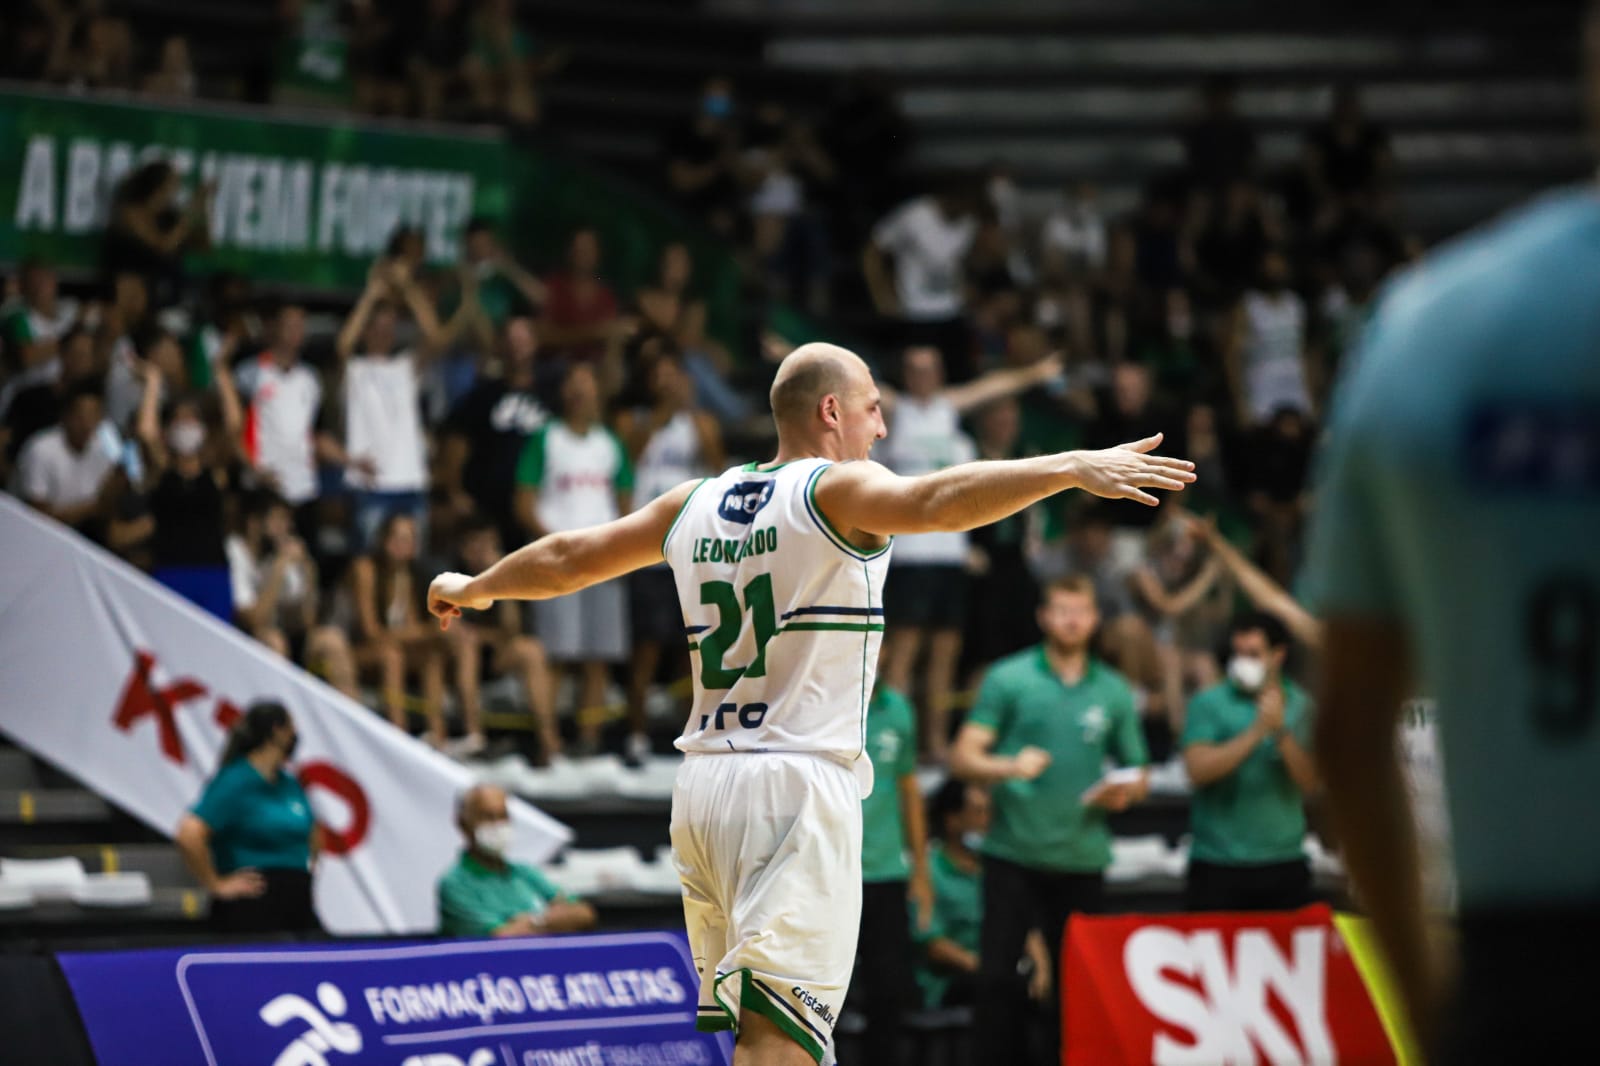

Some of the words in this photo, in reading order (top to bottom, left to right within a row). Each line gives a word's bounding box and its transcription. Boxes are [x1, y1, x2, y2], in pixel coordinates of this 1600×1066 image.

[16, 137, 55, 231] A
[204, 153, 313, 249] VEM
[699, 572, 776, 690] 21
[111, 648, 372, 858] KO
[363, 972, 527, 1025] FORMAÇÃO
[518, 973, 567, 1012] DE
[564, 968, 683, 1008] ATLETAS
[1122, 924, 1338, 1066] SKY
